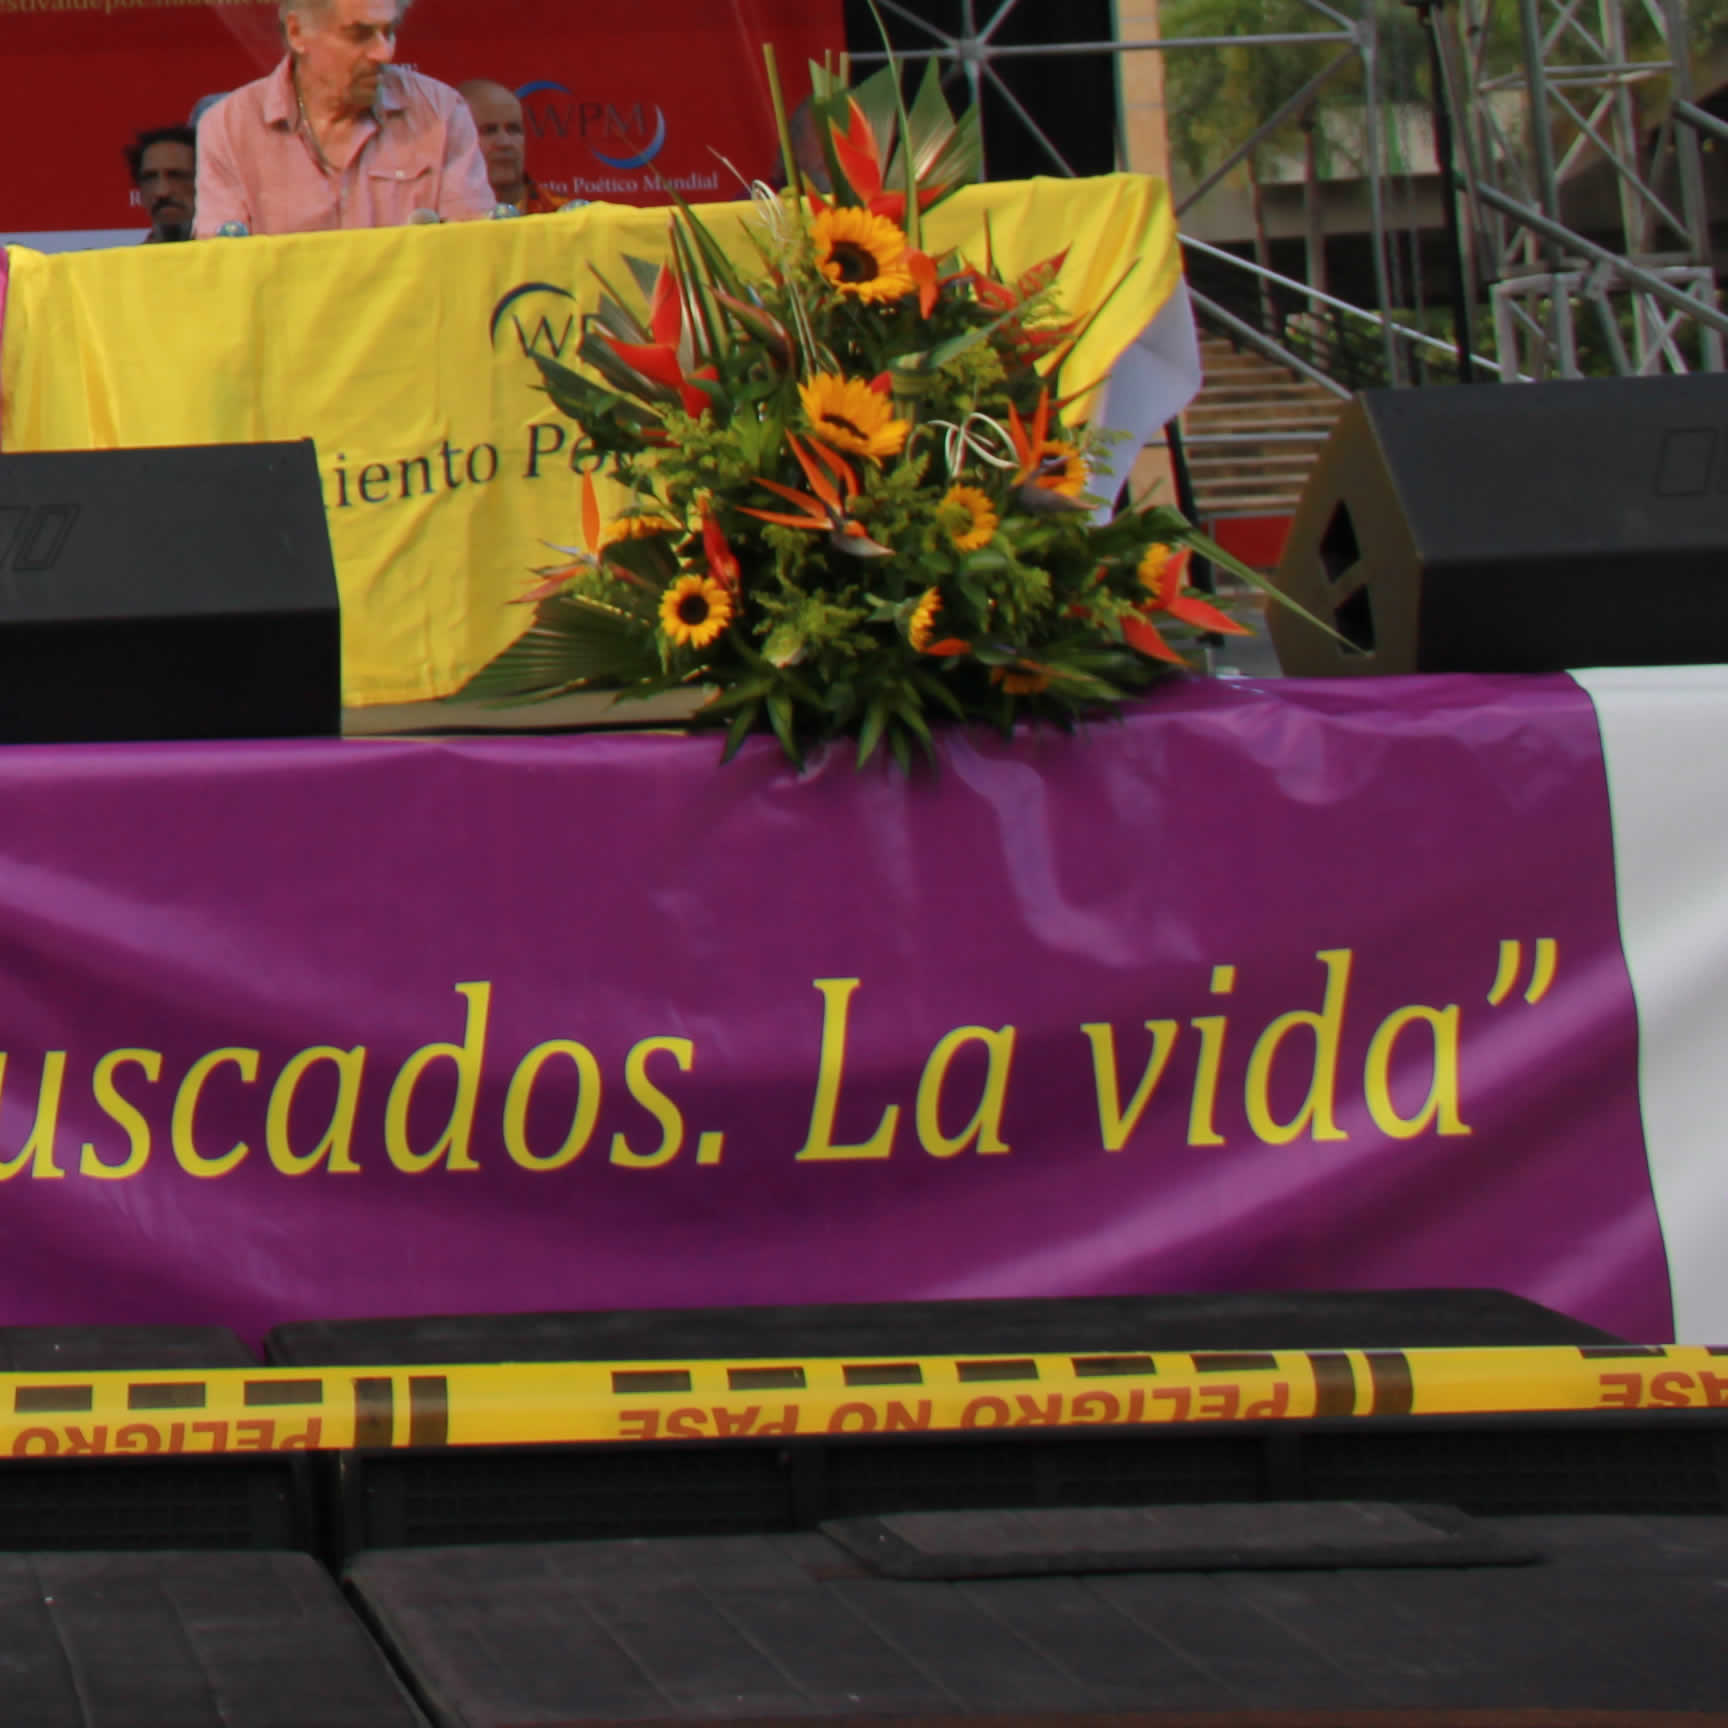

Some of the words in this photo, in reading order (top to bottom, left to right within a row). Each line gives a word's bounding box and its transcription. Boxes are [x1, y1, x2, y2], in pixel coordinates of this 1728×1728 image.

[795, 976, 1015, 1162] La
[1081, 937, 1557, 1152] vida”
[617, 1405, 799, 1440] PASE
[827, 1398, 932, 1435] NO
[961, 1383, 1291, 1431] PELIGRO
[11, 1417, 323, 1459] PELIGRO
